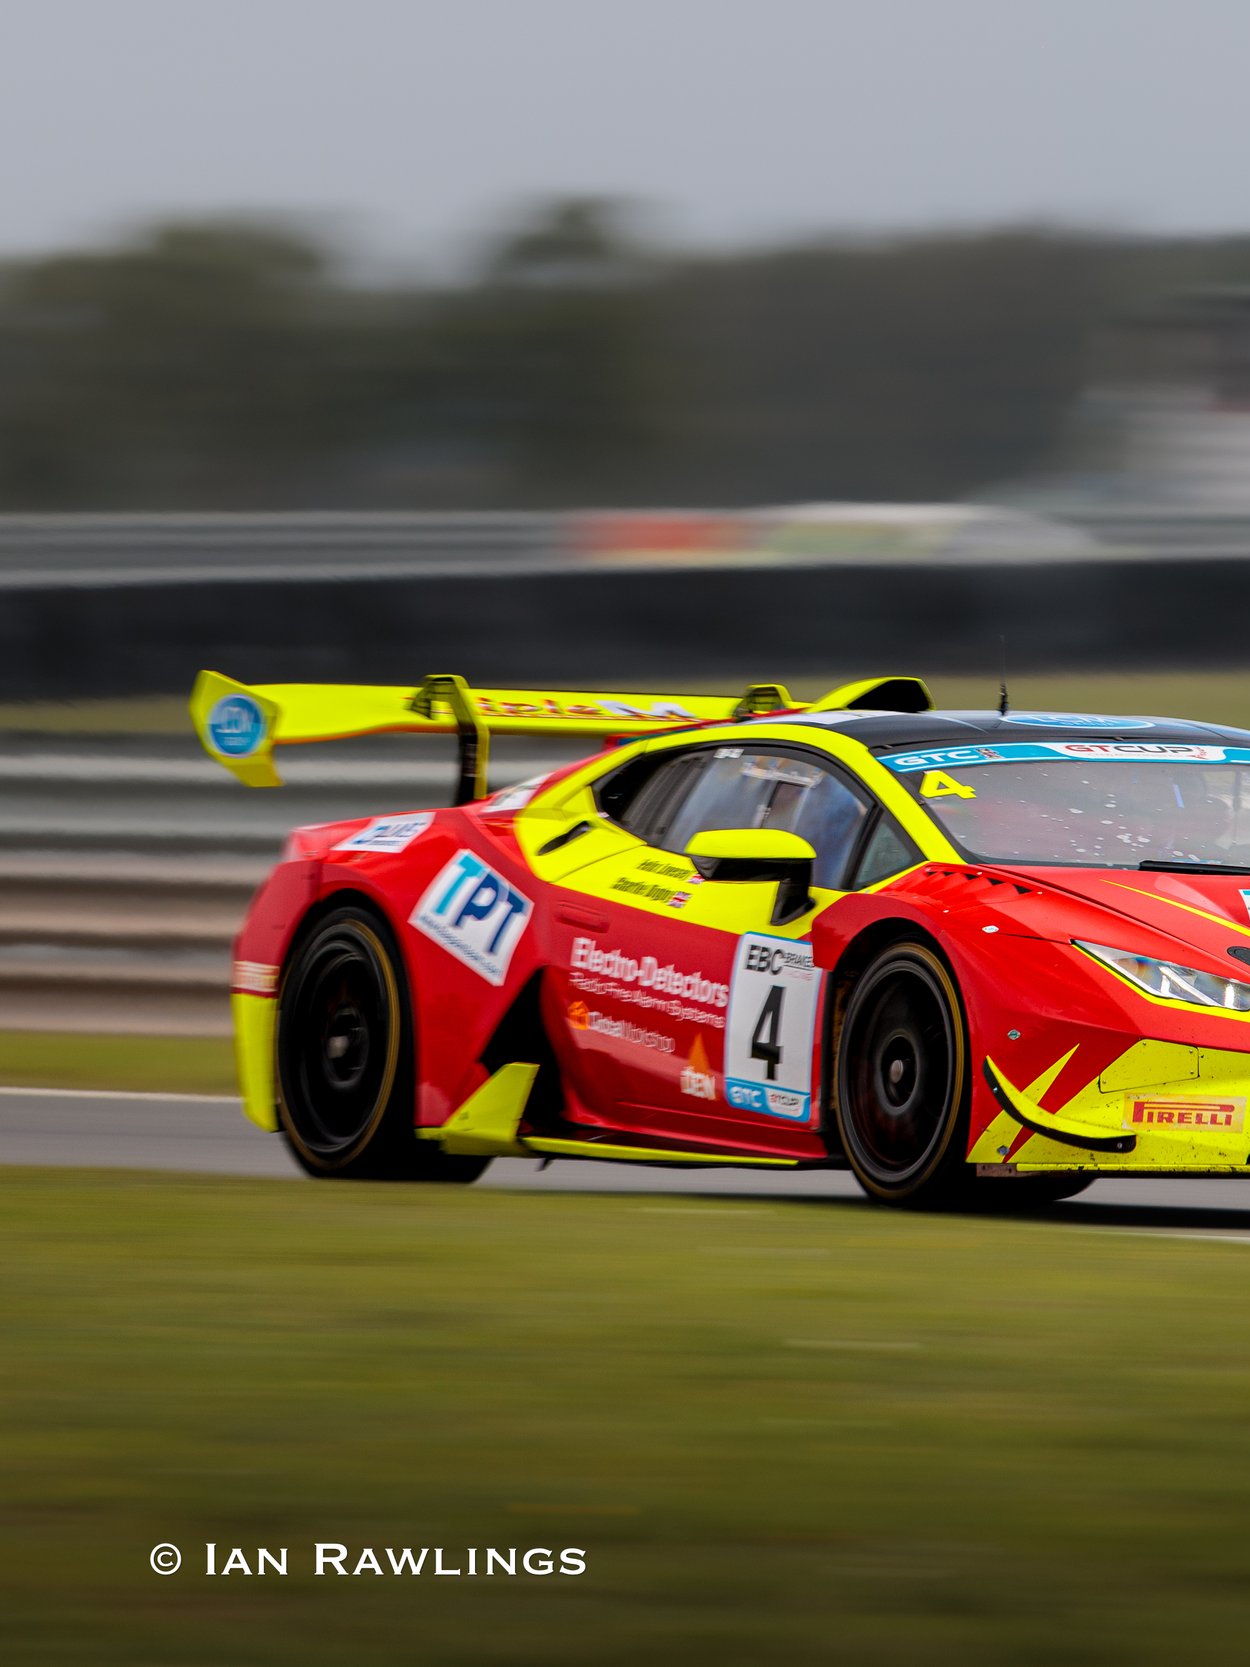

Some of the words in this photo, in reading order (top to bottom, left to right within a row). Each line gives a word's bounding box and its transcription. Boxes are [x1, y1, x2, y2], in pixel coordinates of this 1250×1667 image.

[894, 749, 979, 766] GTC
[919, 770, 977, 799] 4
[434, 854, 525, 953] TPT
[570, 937, 730, 1008] Electro-Detectors
[745, 944, 785, 976] EBC
[784, 952, 815, 968] BRAKE
[750, 985, 786, 1081] 4
[1132, 1101, 1235, 1126] PIRELLI
